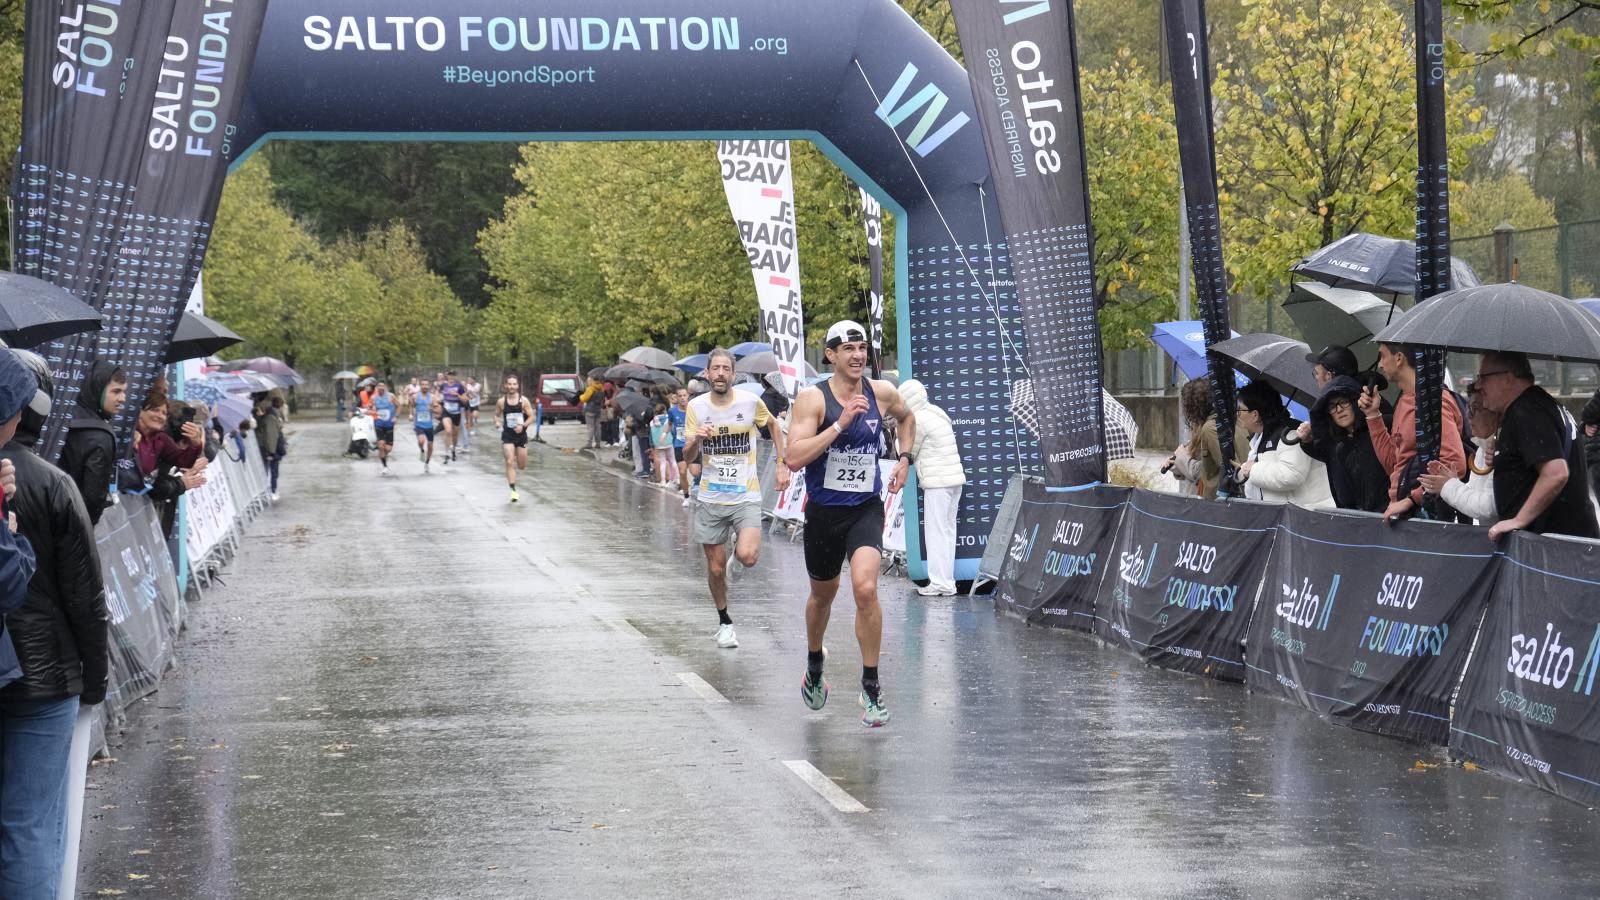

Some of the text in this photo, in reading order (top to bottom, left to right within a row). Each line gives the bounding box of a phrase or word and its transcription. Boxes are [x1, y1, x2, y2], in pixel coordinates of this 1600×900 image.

[303, 15, 788, 54] SALTO FOUNDATION .org
[443, 65, 596, 86] #BeyondSport
[222, 124, 237, 160] .org
[1327, 258, 1371, 273] INESIS
[718, 467, 738, 477] 312
[836, 468, 867, 482] 234
[1175, 541, 1217, 574] SALTO
[1377, 572, 1423, 610] SALTO
[1507, 622, 1574, 690] salto
